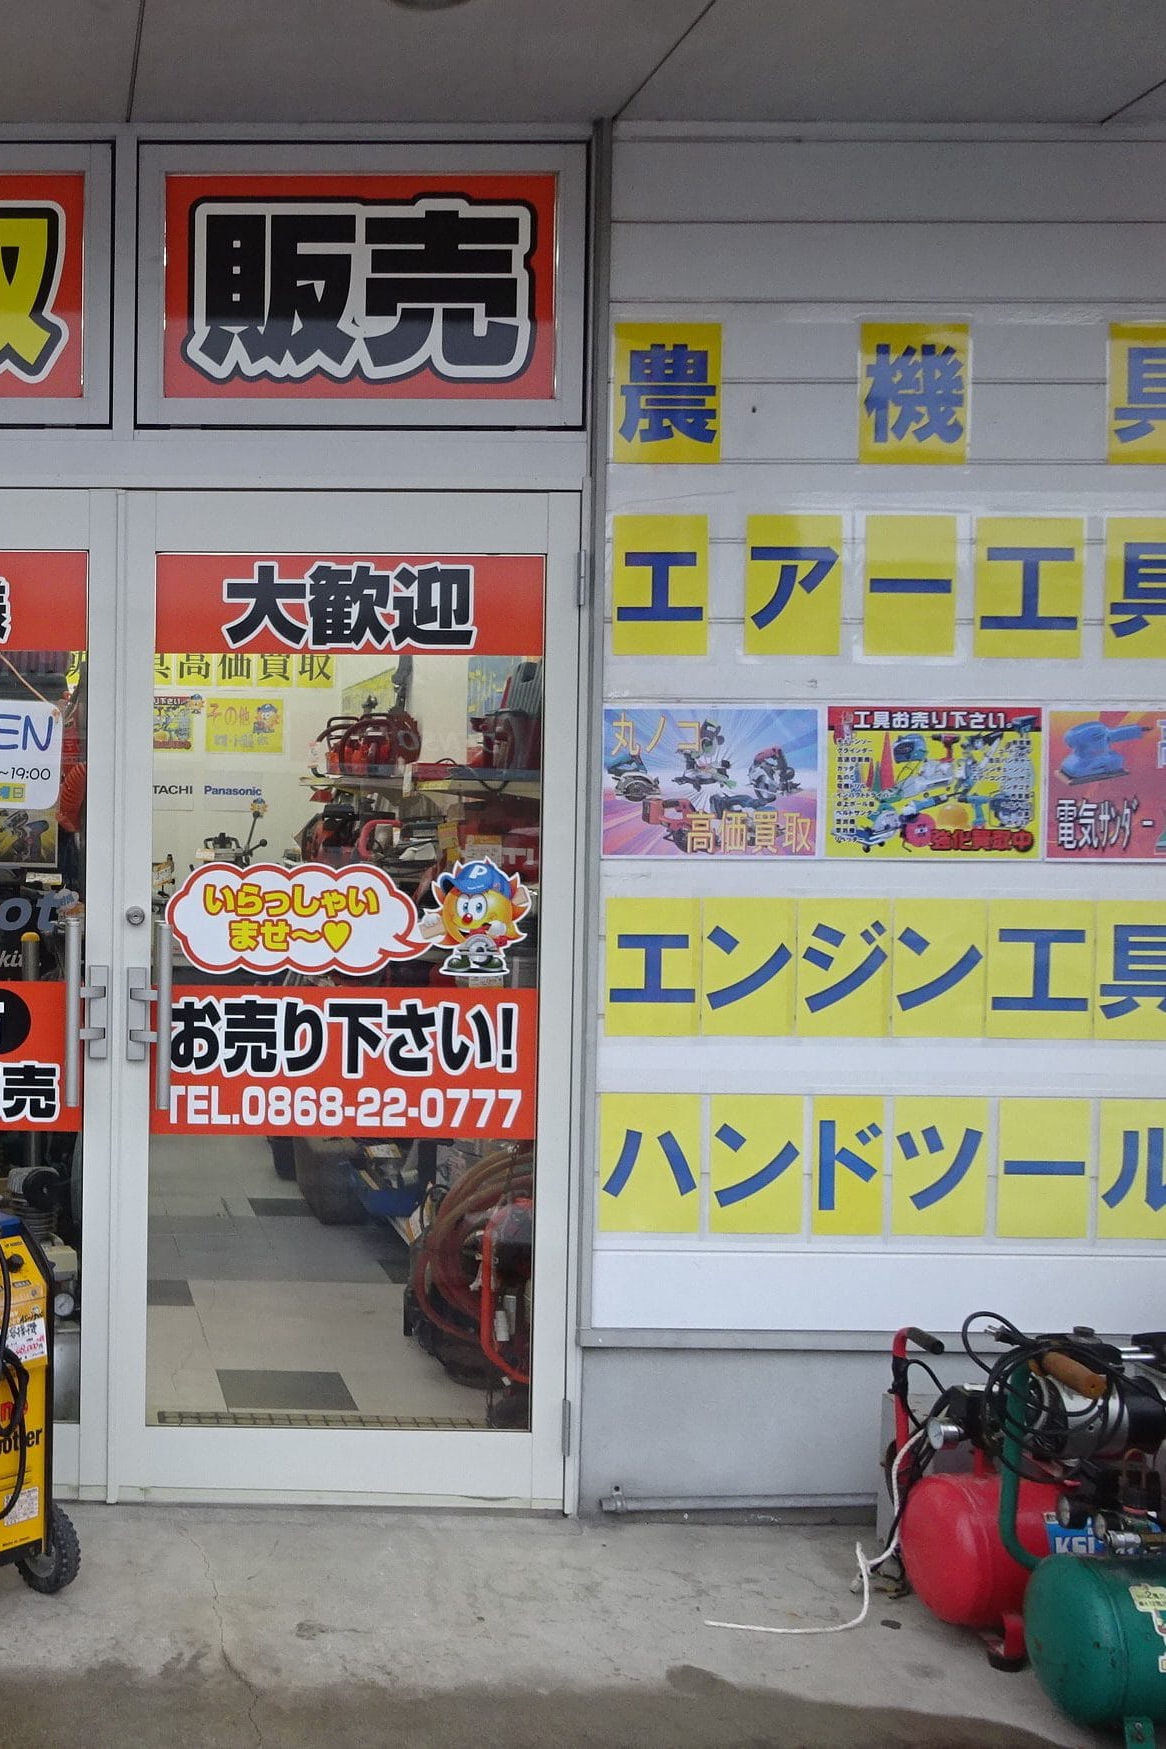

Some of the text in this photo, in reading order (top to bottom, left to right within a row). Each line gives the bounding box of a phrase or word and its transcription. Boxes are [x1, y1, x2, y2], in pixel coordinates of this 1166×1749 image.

[186, 195, 534, 382] 販売
[222, 562, 478, 652] 大歓迎
[204, 785, 262, 796] Panasonic
[686, 810, 811, 855] 高価買取
[202, 883, 380, 919] いらっしゃい
